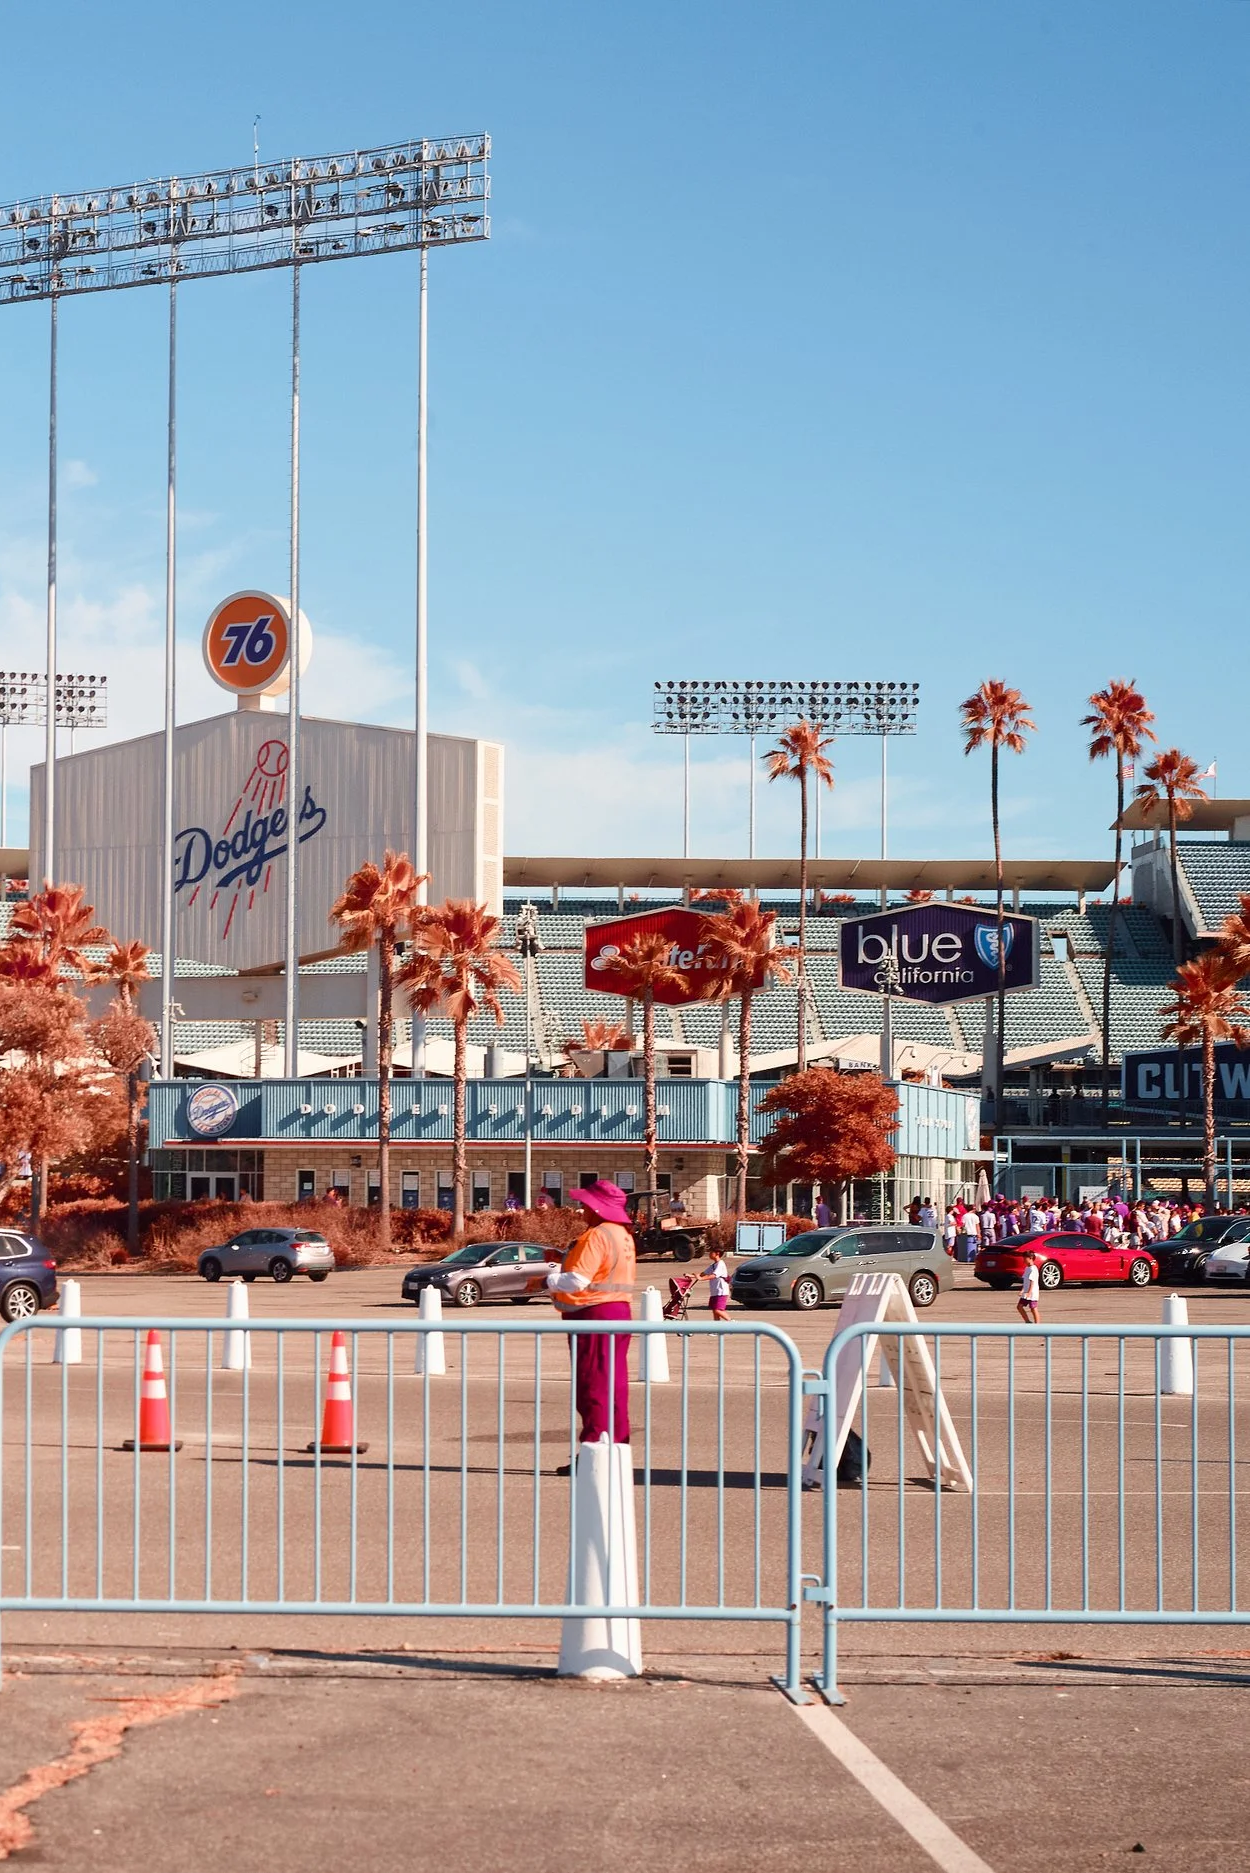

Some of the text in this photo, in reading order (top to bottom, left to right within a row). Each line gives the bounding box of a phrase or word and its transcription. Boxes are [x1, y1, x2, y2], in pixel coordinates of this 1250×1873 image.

[219, 614, 276, 667] 76
[174, 785, 327, 894] Dodges
[857, 924, 963, 965] blue
[488, 1103, 671, 1116] STADIUM
[406, 1159, 556, 1167] TIKES
